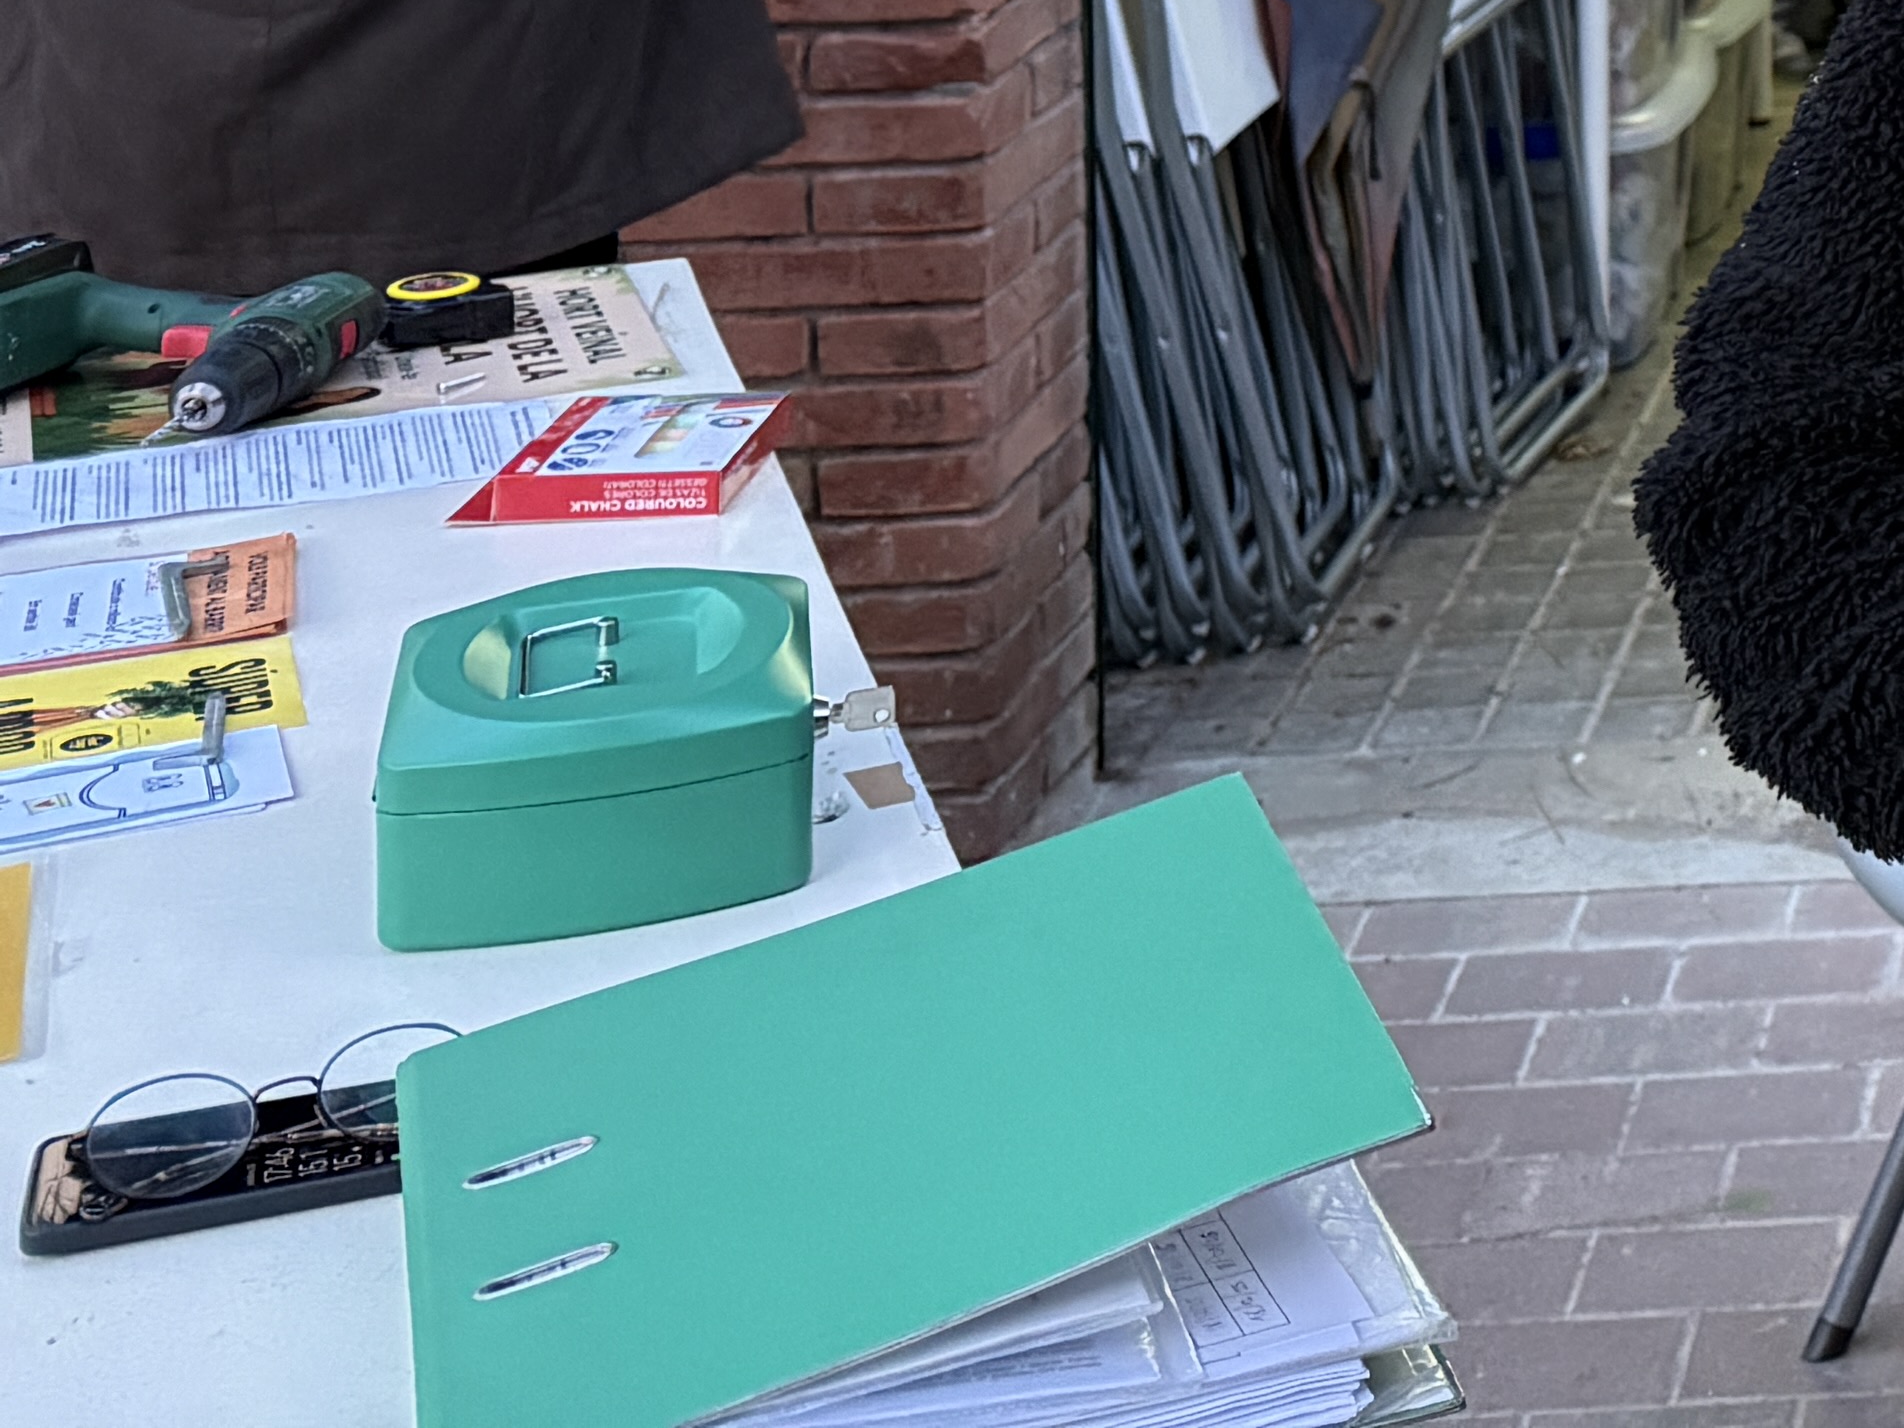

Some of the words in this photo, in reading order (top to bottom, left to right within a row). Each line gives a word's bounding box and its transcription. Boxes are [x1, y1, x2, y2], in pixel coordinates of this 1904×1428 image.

[553, 285, 604, 321] HORT
[506, 337, 559, 361] DE
[516, 358, 568, 383] LA
[570, 499, 621, 513] CHALK
[624, 497, 708, 511] COLOURED
